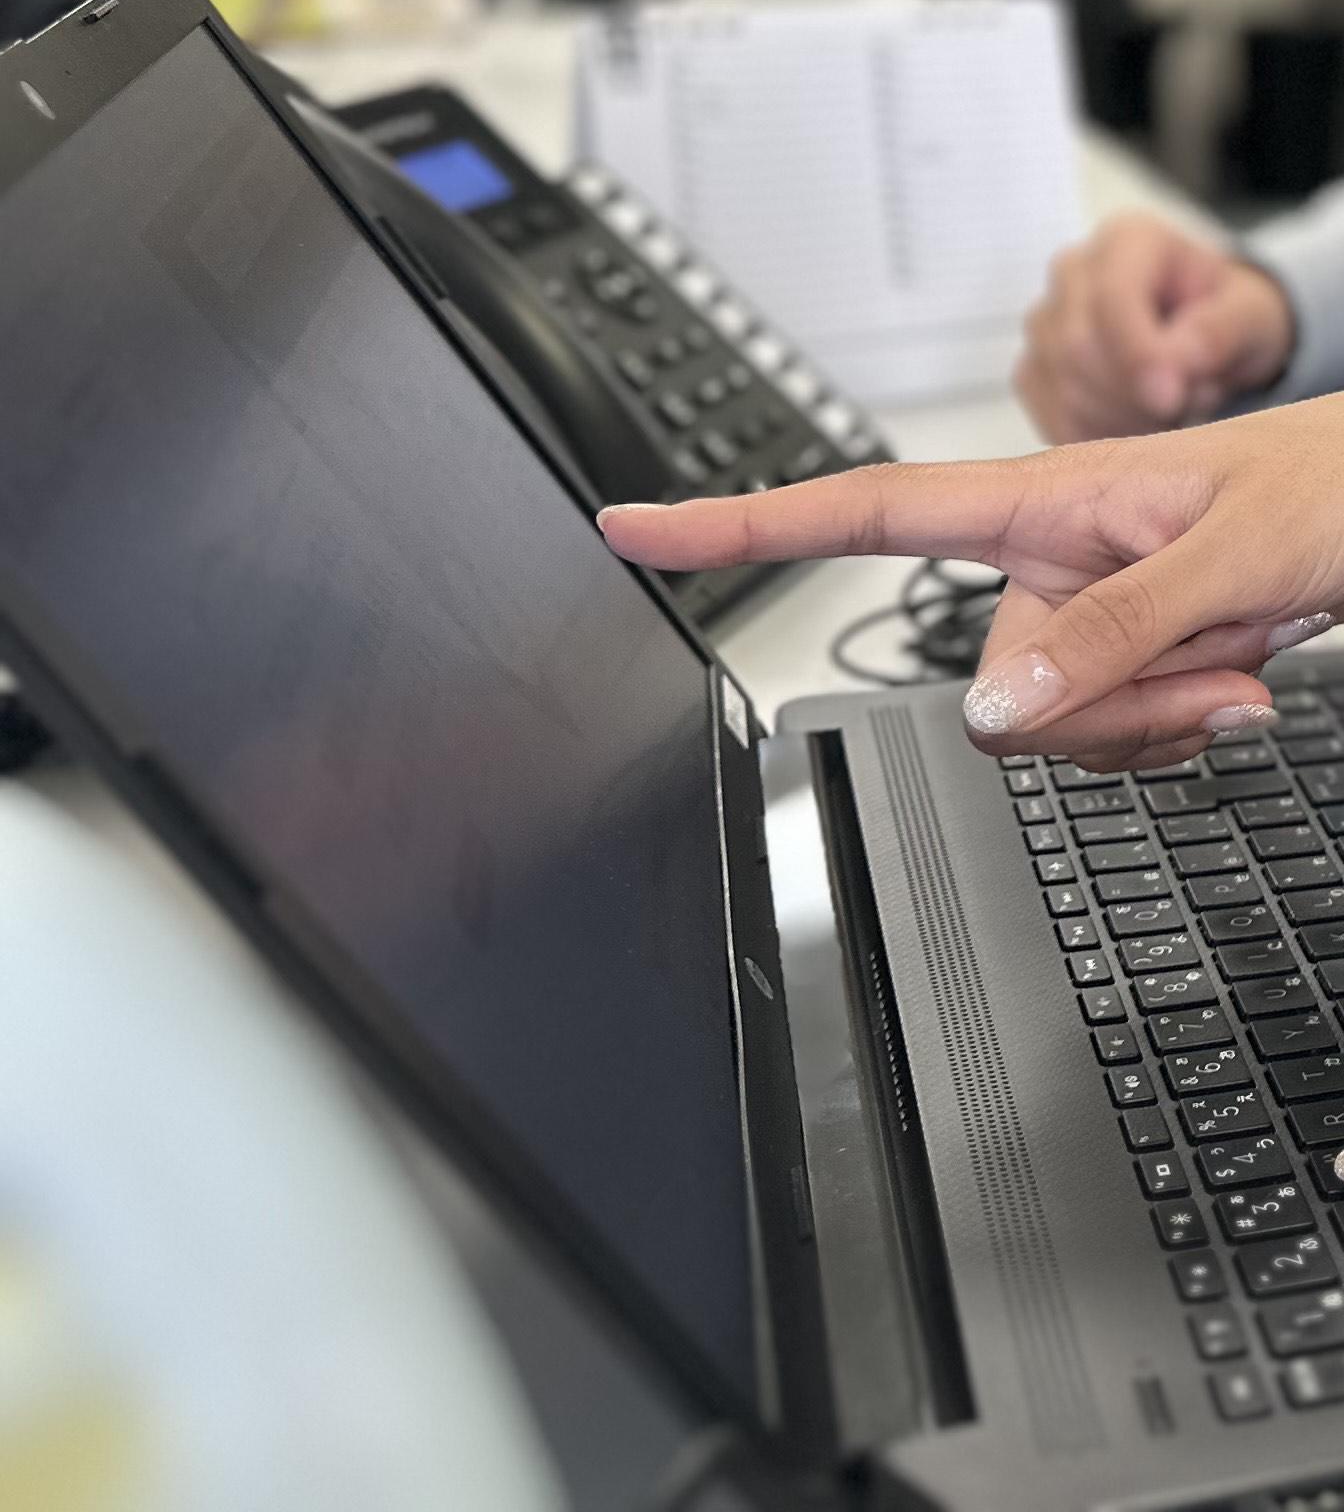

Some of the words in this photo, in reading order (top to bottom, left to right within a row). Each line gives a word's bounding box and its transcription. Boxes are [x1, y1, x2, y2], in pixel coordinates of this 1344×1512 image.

[1315, 898, 1333, 908] L
[1149, 945, 1172, 955] 9
[1164, 982, 1188, 992] 8
[1264, 989, 1287, 999] U
[1178, 1023, 1204, 1032] 7
[1282, 1029, 1304, 1039] Y
[1196, 1062, 1221, 1074] 6
[1302, 1071, 1325, 1081] T
[1213, 1106, 1240, 1118] 5
[1232, 1152, 1257, 1164] 4
[1252, 1201, 1280, 1214] 3
[1273, 1254, 1304, 1268] 2
